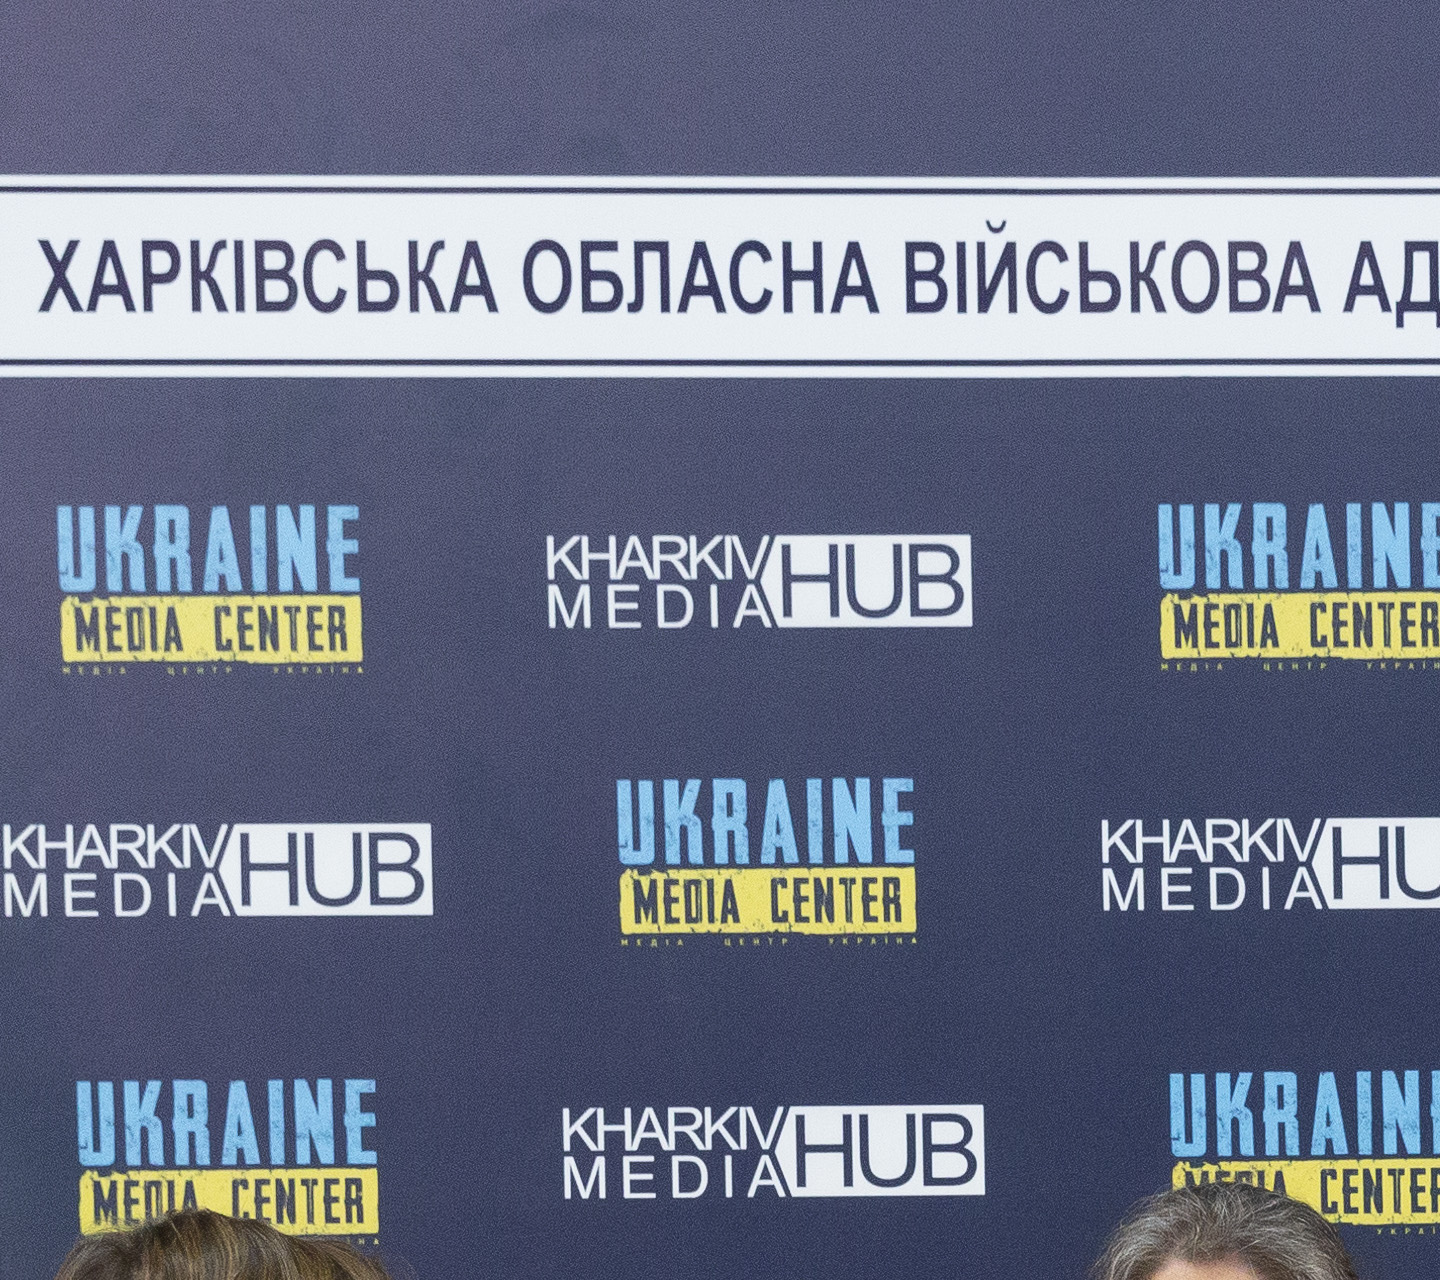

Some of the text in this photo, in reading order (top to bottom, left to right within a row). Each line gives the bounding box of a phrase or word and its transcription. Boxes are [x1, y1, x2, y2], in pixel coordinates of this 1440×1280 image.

[39, 239, 498, 313] ХАРКІВСЬКА
[523, 239, 879, 314] ОБЛАСНА
[905, 221, 1321, 314] ВІЙСЬКОВА
[56, 503, 361, 593] UKRAINE
[547, 535, 769, 580] KHARKIV
[782, 544, 964, 618] HUB
[74, 605, 348, 652] MEDIA CENTER
[548, 584, 771, 628] MEDIA
[1173, 602, 1439, 649] MEDIA CENTER
[616, 777, 915, 866] UKRAINE
[1102, 818, 1320, 863] KHARKIV
[3, 824, 228, 869] KHARKIV
[240, 832, 424, 907] HUB
[4, 873, 230, 917] MEDIA
[632, 877, 901, 925] MEDIA CENTER
[1103, 867, 1322, 911] MEDIA
[76, 1078, 377, 1167] UKRAINE
[563, 1106, 783, 1151] KHARKIV
[796, 1113, 977, 1187] HUB
[564, 1155, 785, 1199] MEDIA
[92, 1177, 363, 1226] MEDIA CENTER
